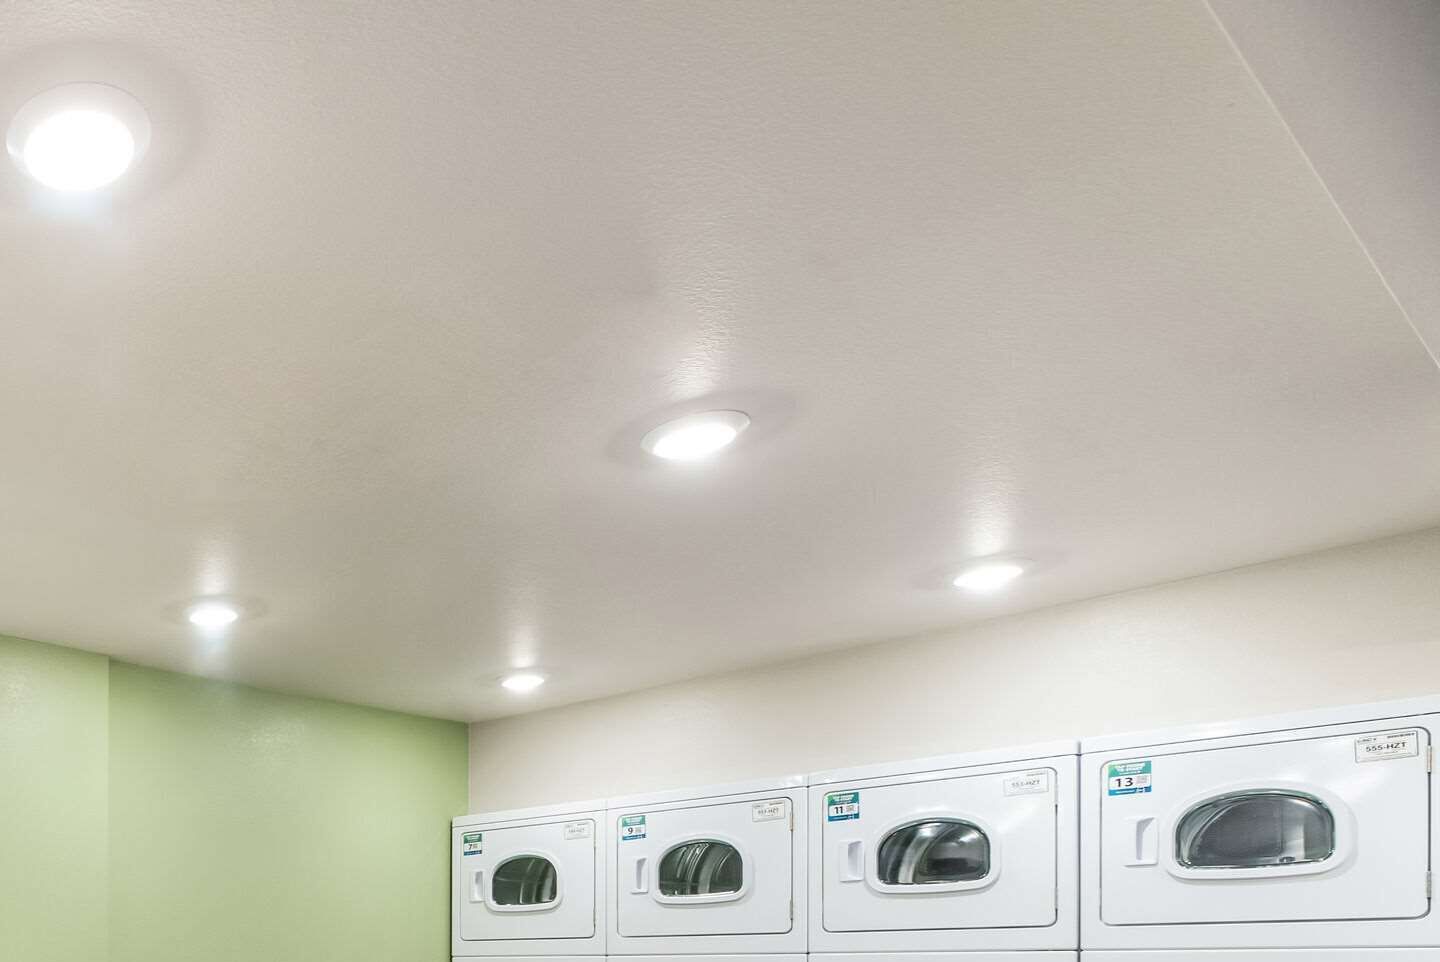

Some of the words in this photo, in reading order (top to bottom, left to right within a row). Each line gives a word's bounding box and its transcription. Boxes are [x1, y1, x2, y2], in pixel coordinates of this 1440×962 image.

[1115, 777, 1133, 787] 13
[834, 806, 843, 814] 11
[628, 827, 633, 835] 9
